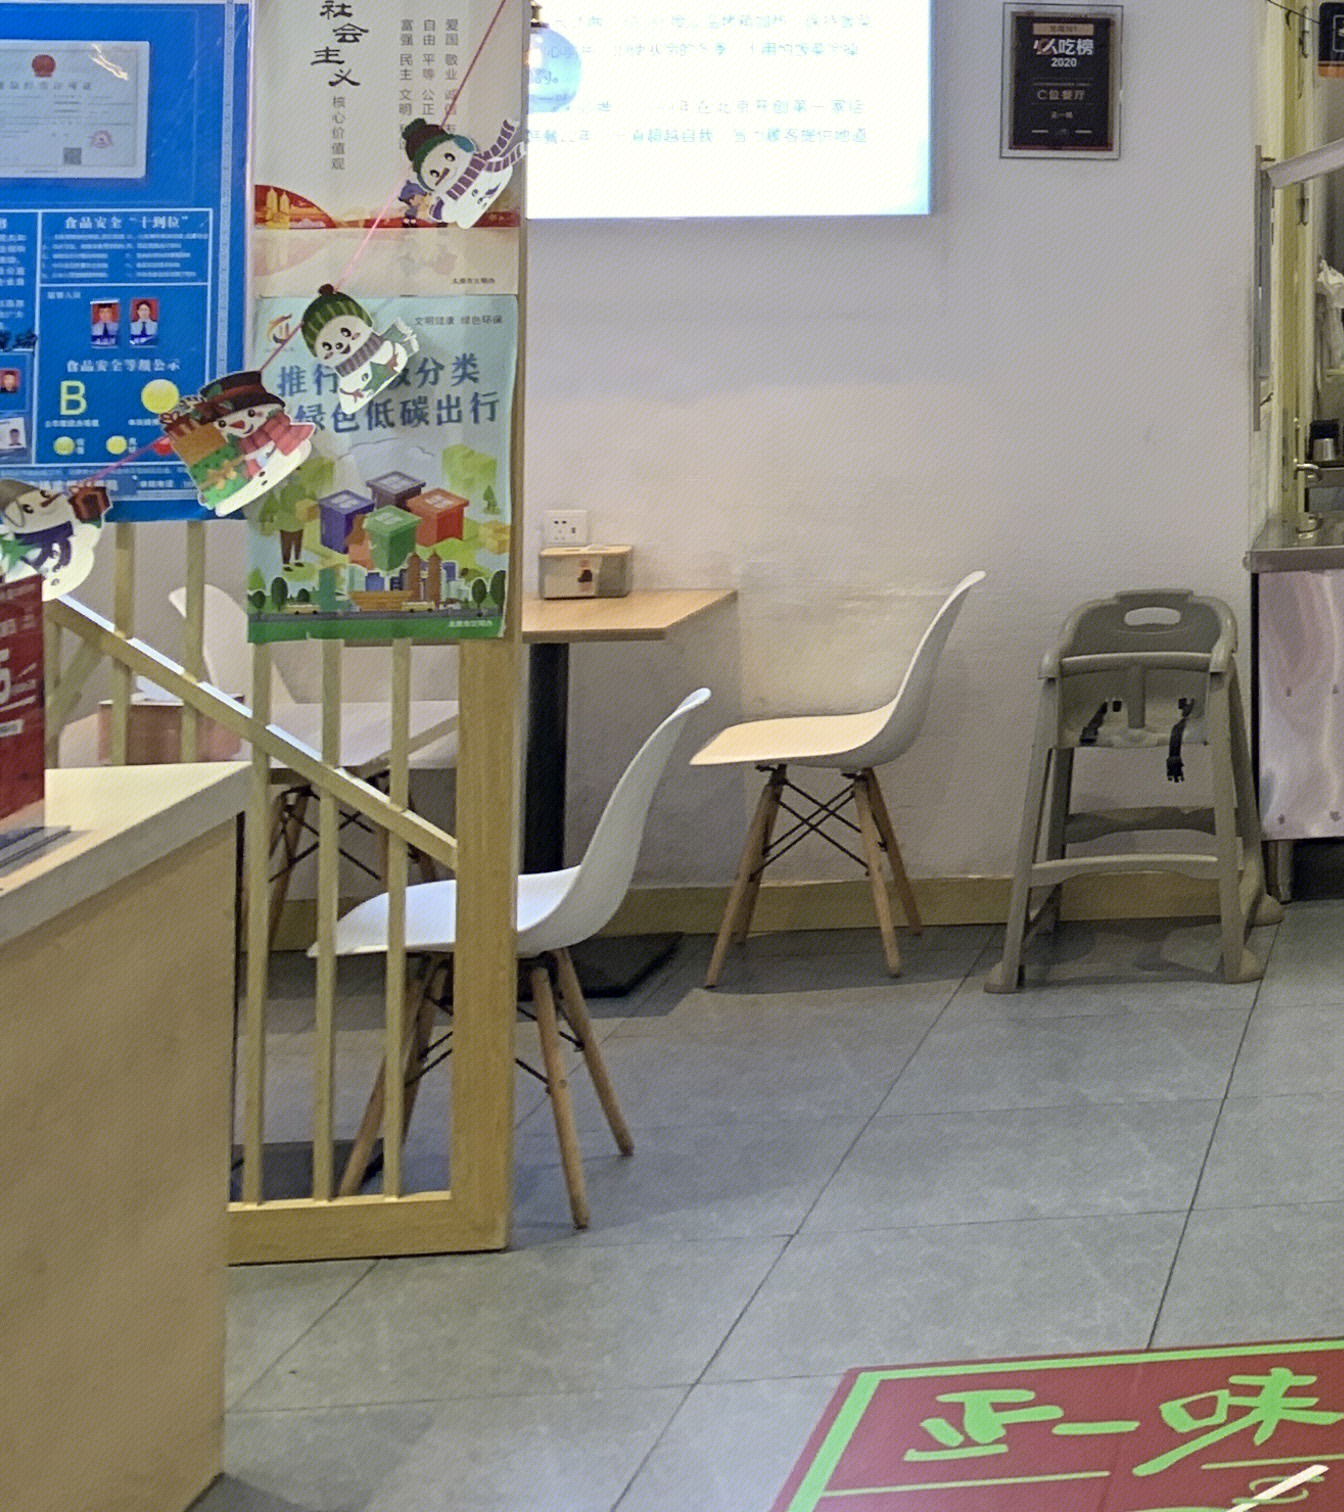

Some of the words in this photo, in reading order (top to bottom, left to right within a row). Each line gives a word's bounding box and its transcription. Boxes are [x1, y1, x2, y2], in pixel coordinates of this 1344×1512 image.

[310, 0, 370, 87] 社会主义
[400, 18, 414, 46] 富强
[422, 19, 436, 46] 自由
[445, 18, 459, 46] 爱国
[400, 53, 413, 81] 民主
[422, 53, 436, 80] 平等
[444, 53, 459, 81] 敬业
[1050, 56, 1078, 68] 2020
[399, 88, 413, 116] 文明
[422, 88, 435, 115] 公正
[330, 95, 347, 171] 核心价值观
[276, 352, 481, 398] 推行分类
[59, 379, 88, 416] B
[294, 391, 500, 434] 绿色低碳出行
